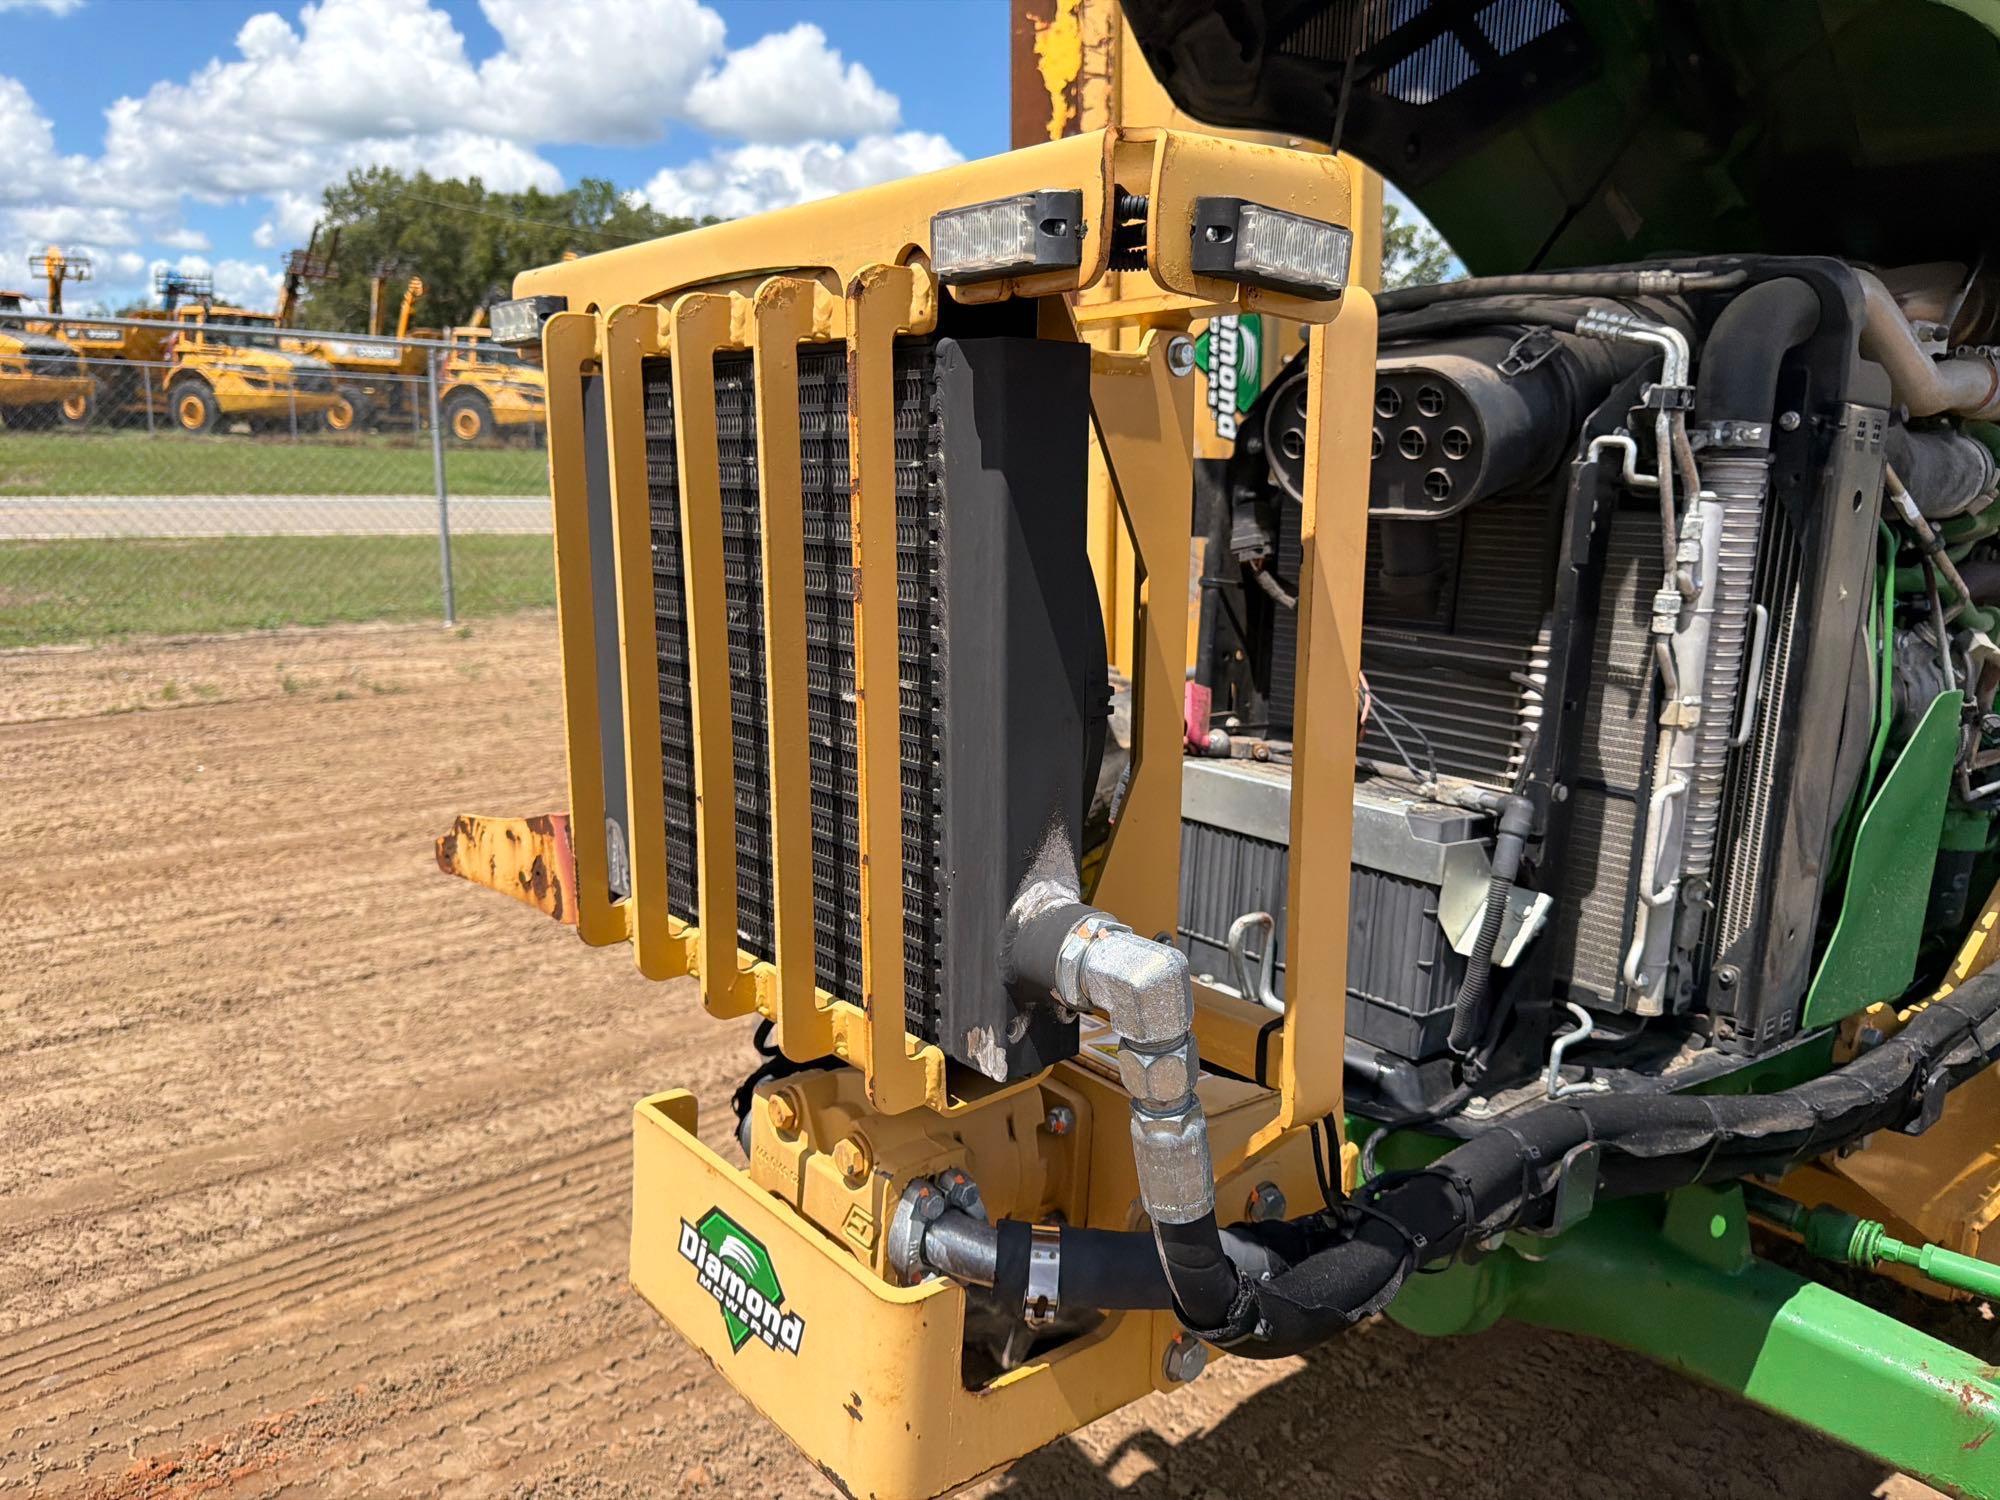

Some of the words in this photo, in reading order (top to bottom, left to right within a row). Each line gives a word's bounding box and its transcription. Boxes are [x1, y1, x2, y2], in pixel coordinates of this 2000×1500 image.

[1208, 316, 1219, 406] OWERS
[681, 1223, 803, 1352] Diamond
[700, 1273, 775, 1347] MOWERS
